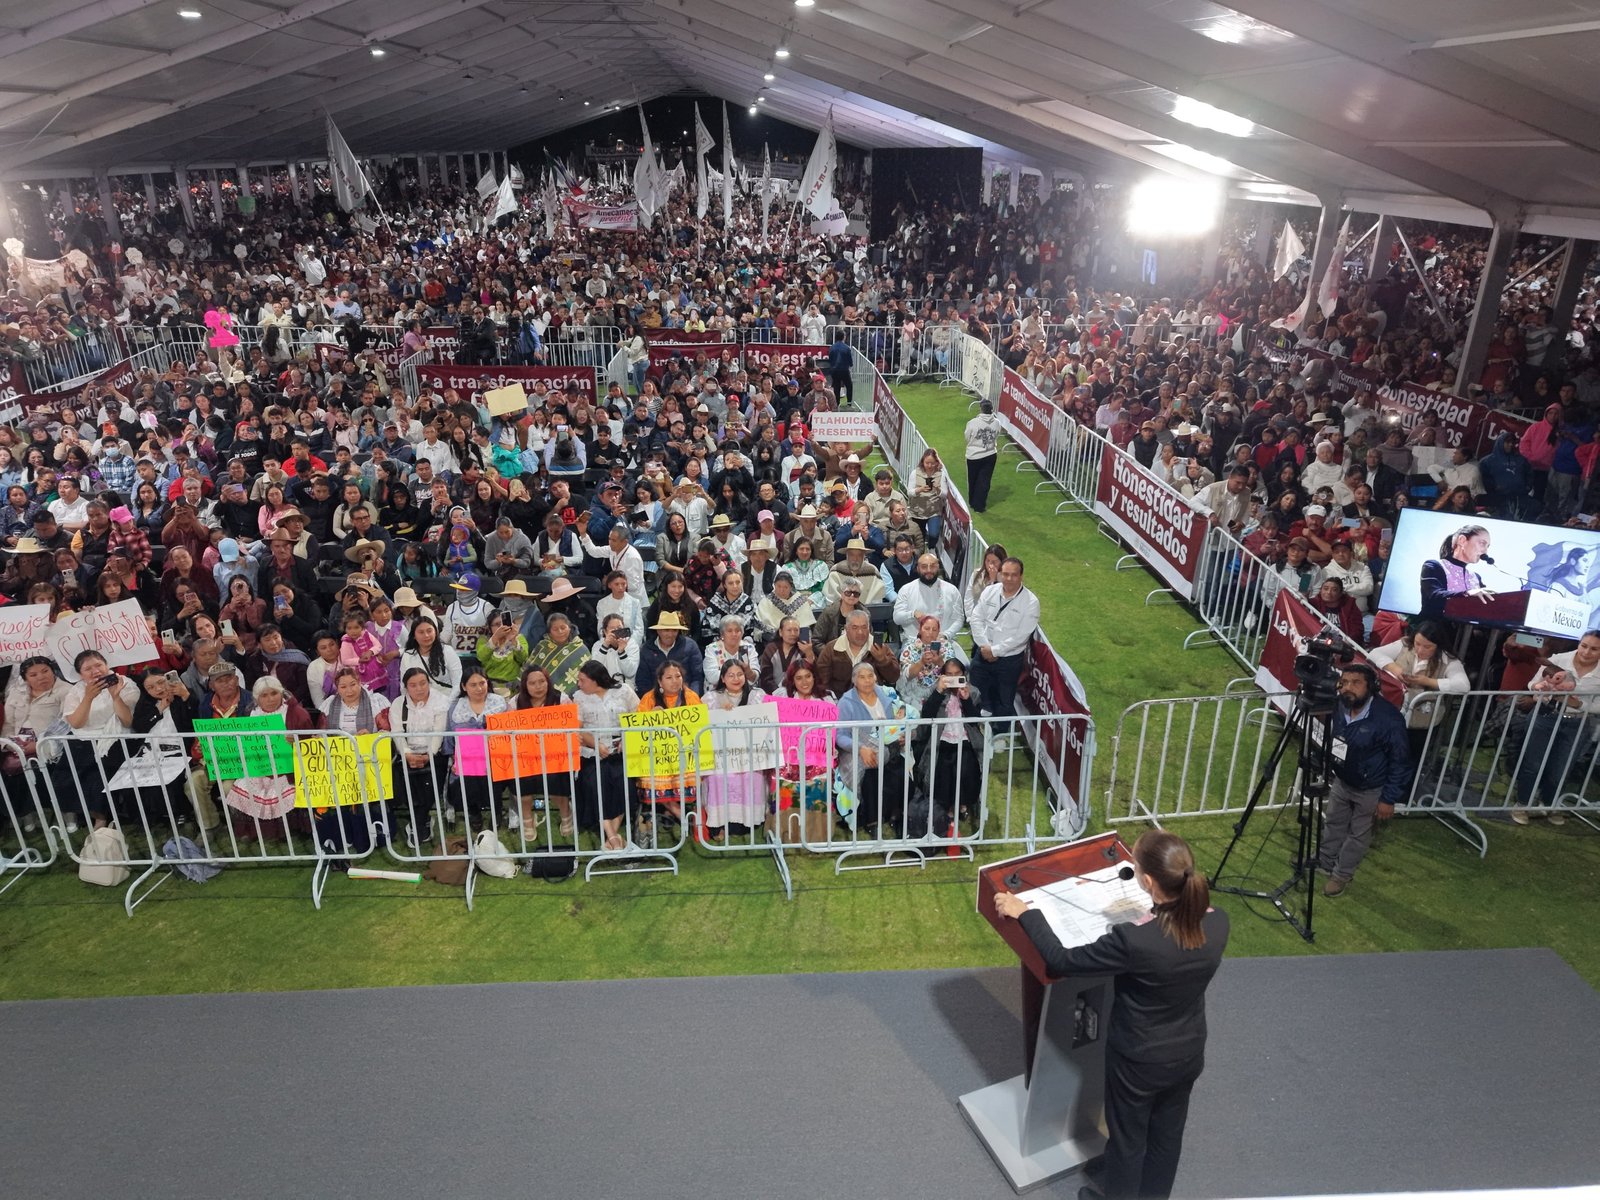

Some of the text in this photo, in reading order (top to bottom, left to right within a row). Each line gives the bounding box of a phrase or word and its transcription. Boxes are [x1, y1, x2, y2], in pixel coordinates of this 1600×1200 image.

[421, 374, 443, 389] La
[1003, 376, 1010, 394] La
[813, 416, 873, 424] TLAHUICAS
[1014, 406, 1034, 432] avanza
[812, 428, 872, 436] PRESENTES
[1113, 453, 1195, 539] Honestidad
[1108, 485, 1188, 565] y resultados
[71, 611, 111, 628] CON
[1274, 610, 1288, 637] La
[1552, 611, 1581, 629] México
[456, 635, 477, 650] 23
[622, 707, 700, 727] TE AMAMOS
[641, 723, 691, 741] CAUDIA
